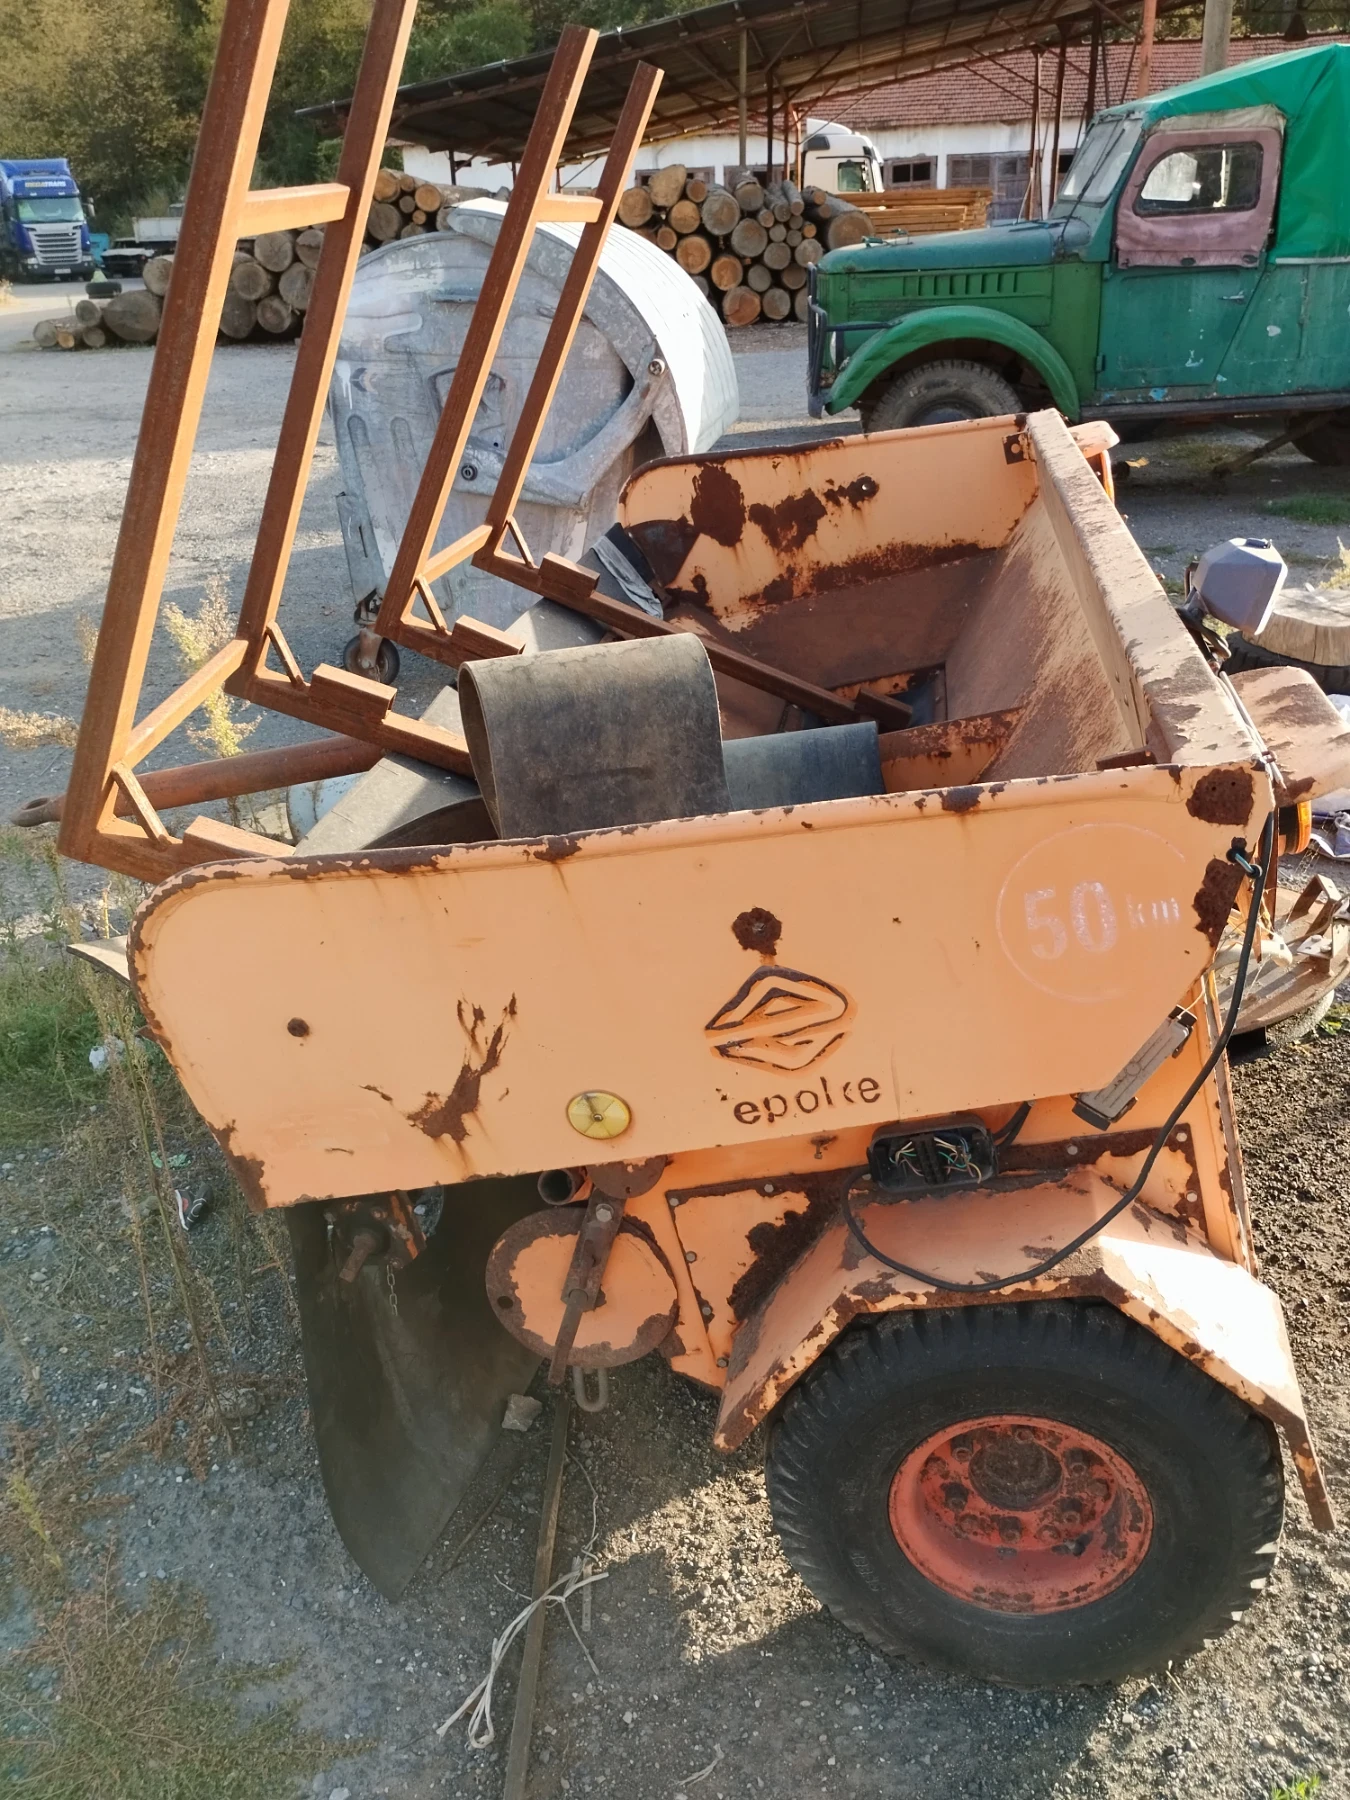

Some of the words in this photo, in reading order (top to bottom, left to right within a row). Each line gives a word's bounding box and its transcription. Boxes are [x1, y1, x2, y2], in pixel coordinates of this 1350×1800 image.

[1025, 881, 1118, 960] 50
[1126, 894, 1182, 929] km
[733, 1076, 881, 1125] epoke
